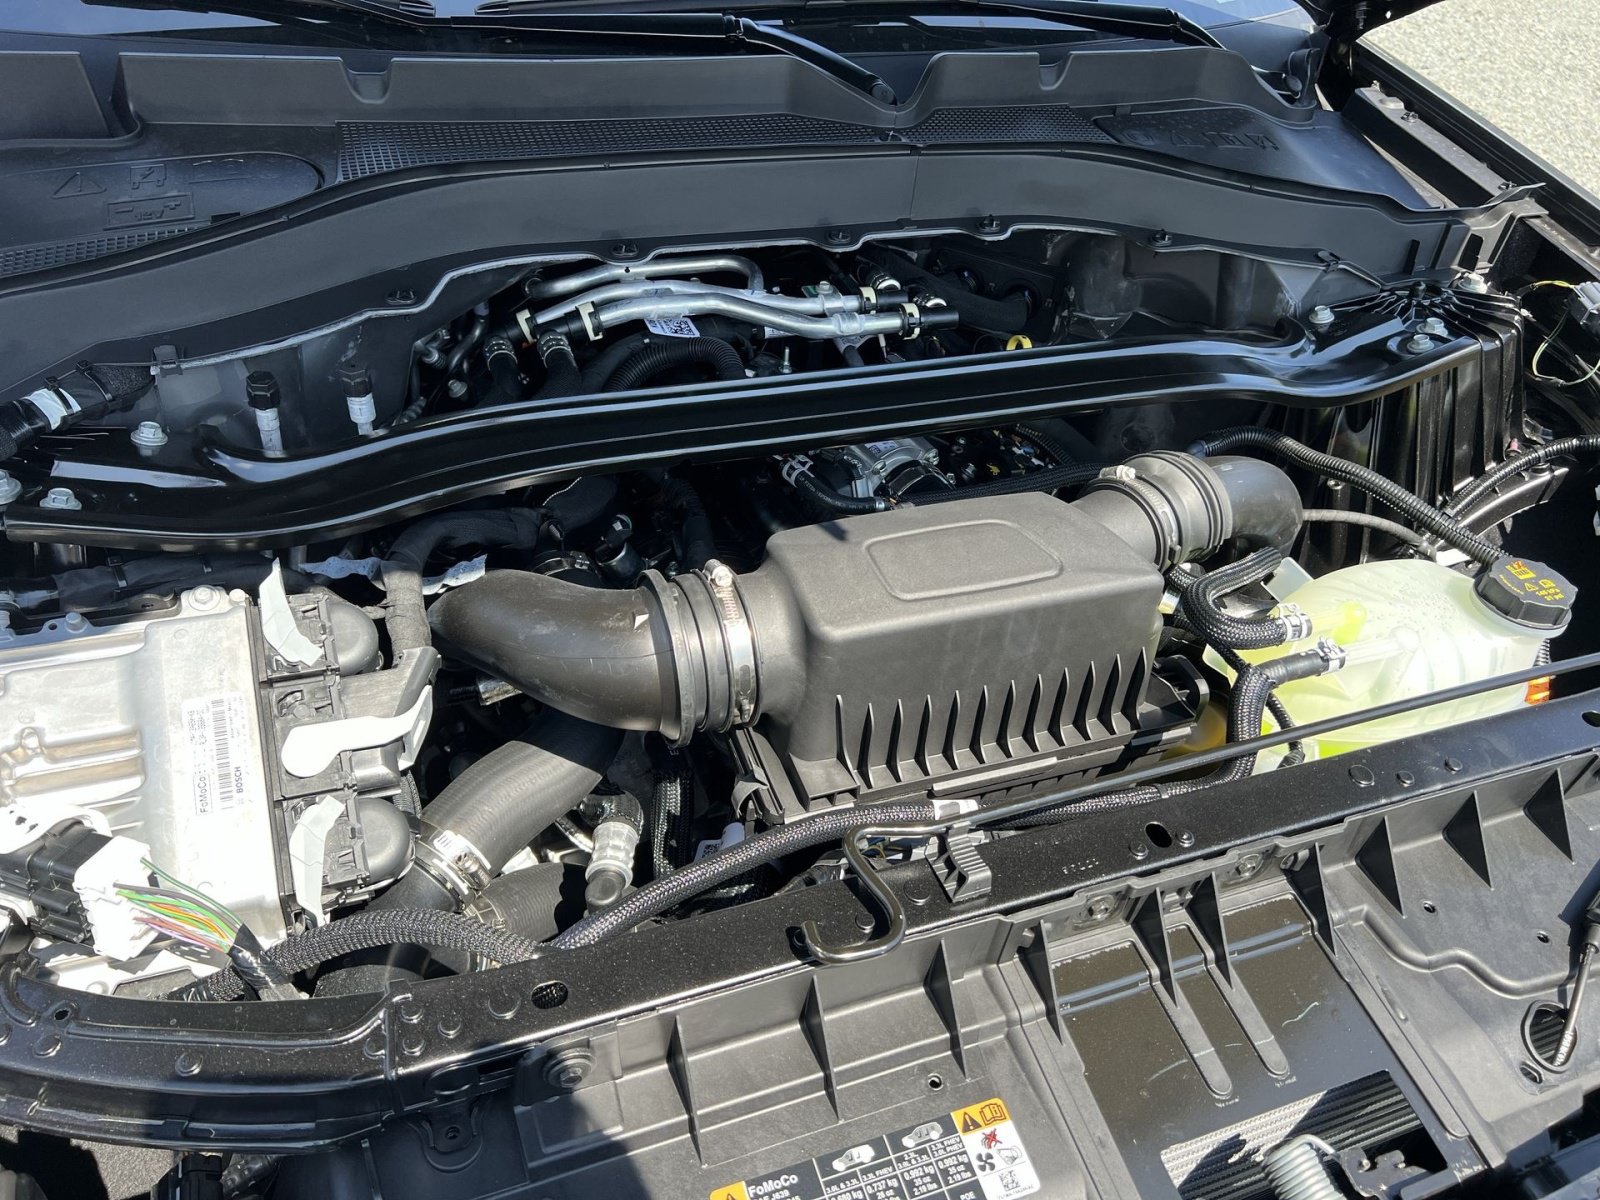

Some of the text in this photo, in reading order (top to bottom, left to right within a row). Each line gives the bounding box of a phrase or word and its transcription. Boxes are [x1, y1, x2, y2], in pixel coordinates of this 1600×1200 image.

[234, 766, 244, 793] BOSCH
[197, 776, 208, 813] FoMoCo
[938, 1154, 968, 1169] 0.992 kg
[903, 1164, 935, 1181] 0.992 kg
[948, 1164, 965, 1175] 35 oz
[914, 1175, 931, 1186] 35 oz
[947, 1171, 972, 1184] 2.19 lbs
[748, 1174, 798, 1198] FoMoCo
[851, 1188, 863, 1199] kg
[866, 1178, 898, 1194] 0.737 kg
[913, 1183, 937, 1196] 2.19 lbs
